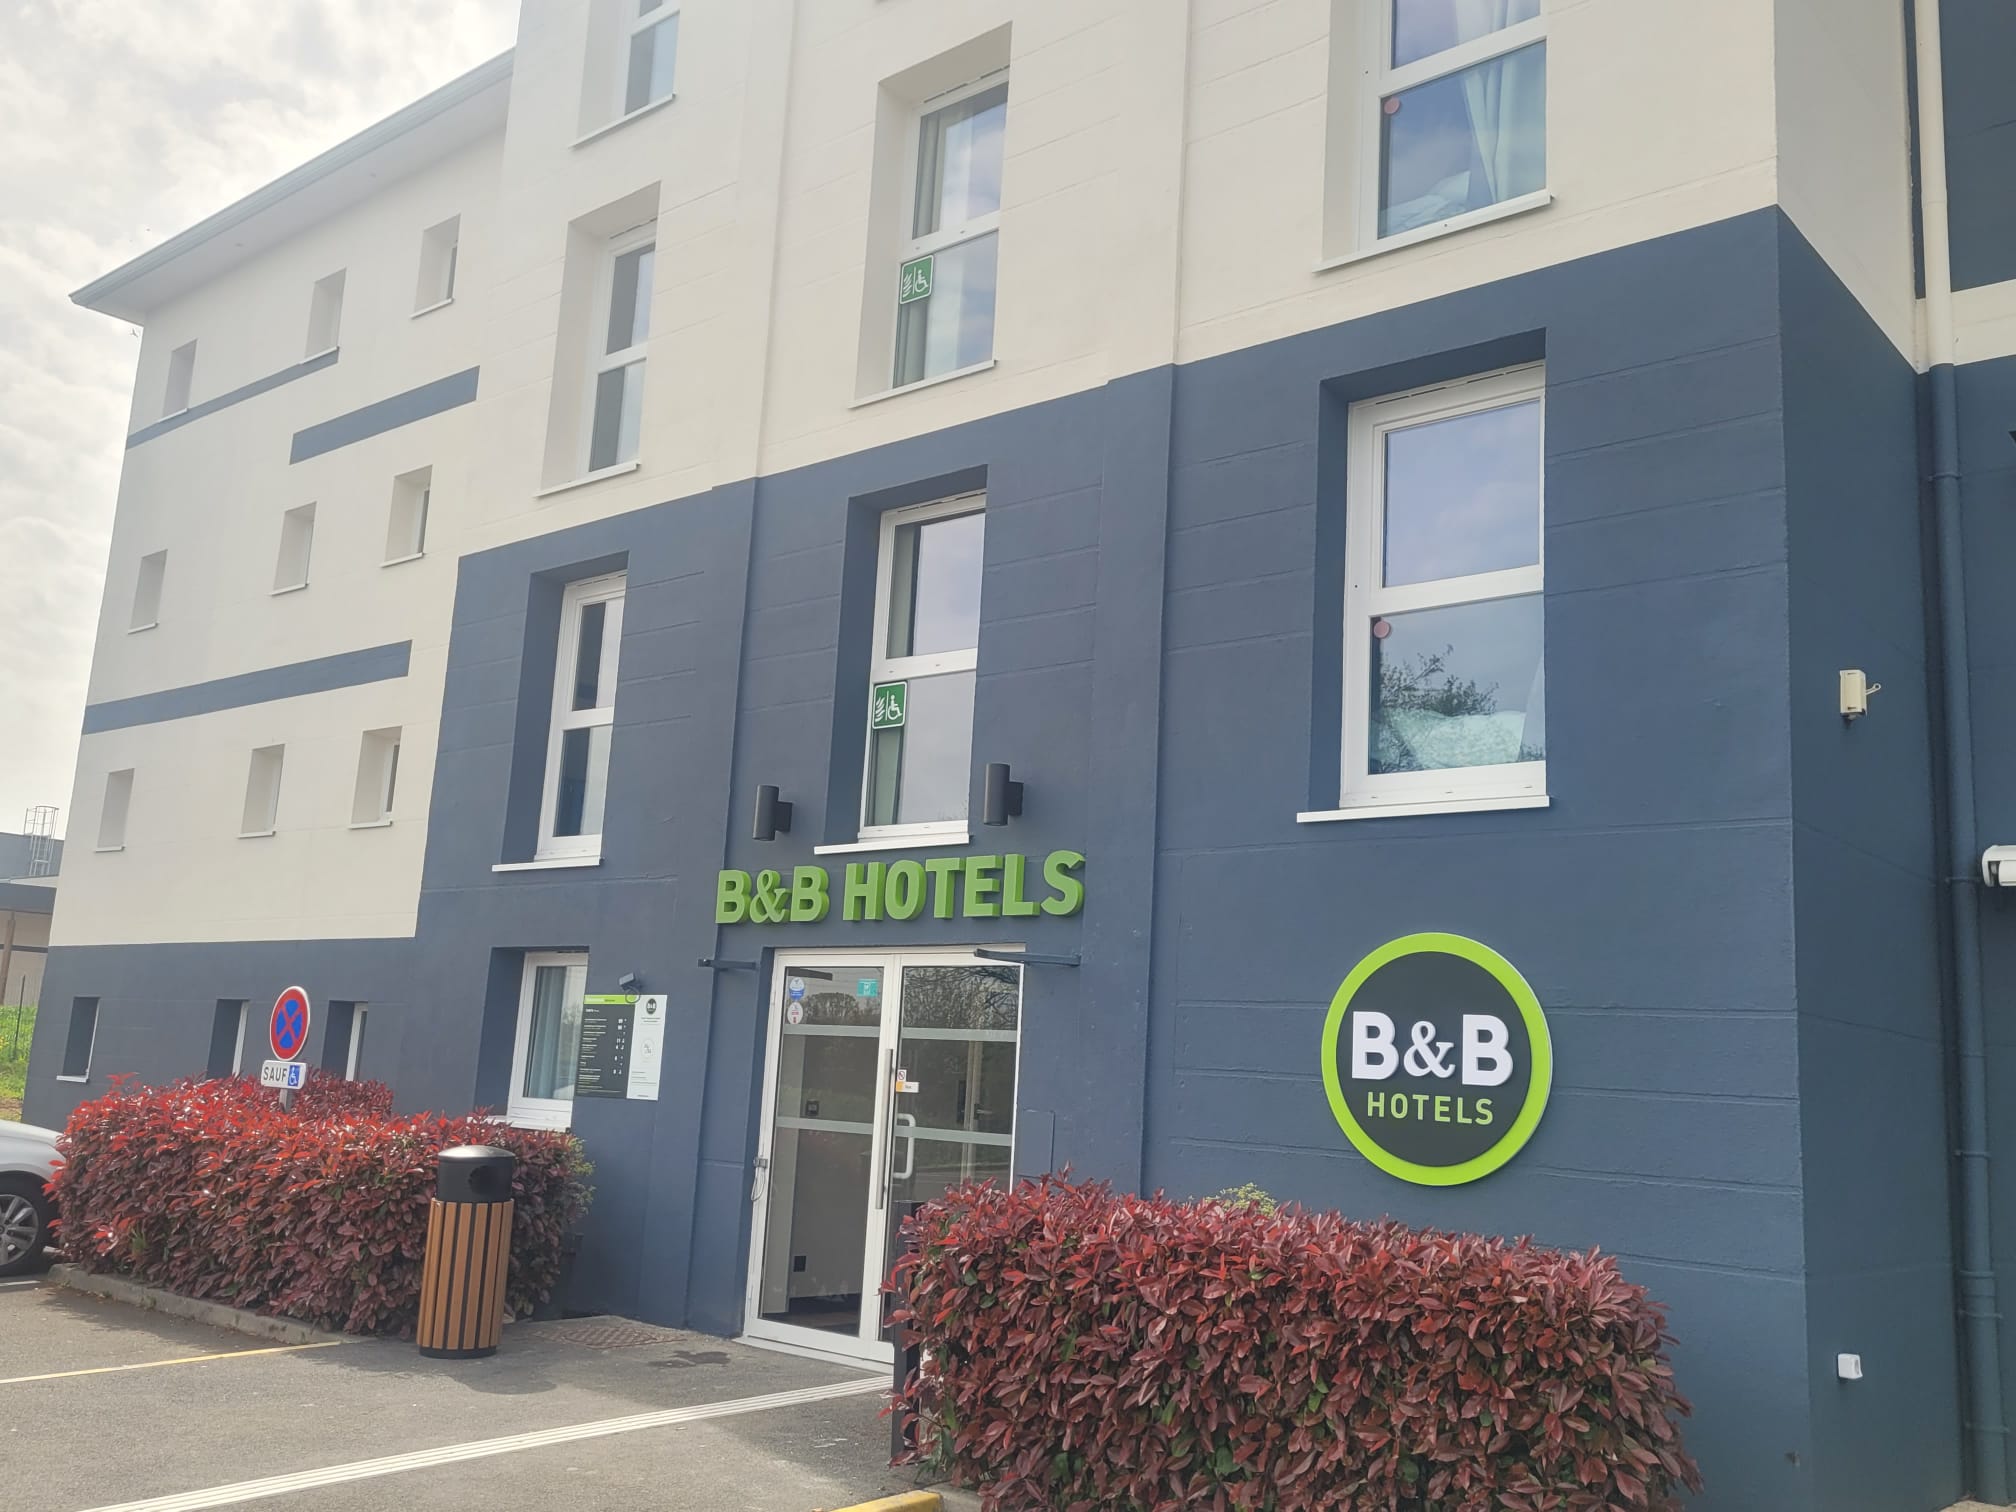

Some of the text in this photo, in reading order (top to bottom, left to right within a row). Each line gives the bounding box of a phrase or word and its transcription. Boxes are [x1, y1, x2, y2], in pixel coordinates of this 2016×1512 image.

[715, 849, 1086, 924] B&B HOTELS
[263, 1066, 287, 1082] SAUF
[1352, 1011, 1514, 1086] B&B
[1368, 1092, 1493, 1125] HOTELS
